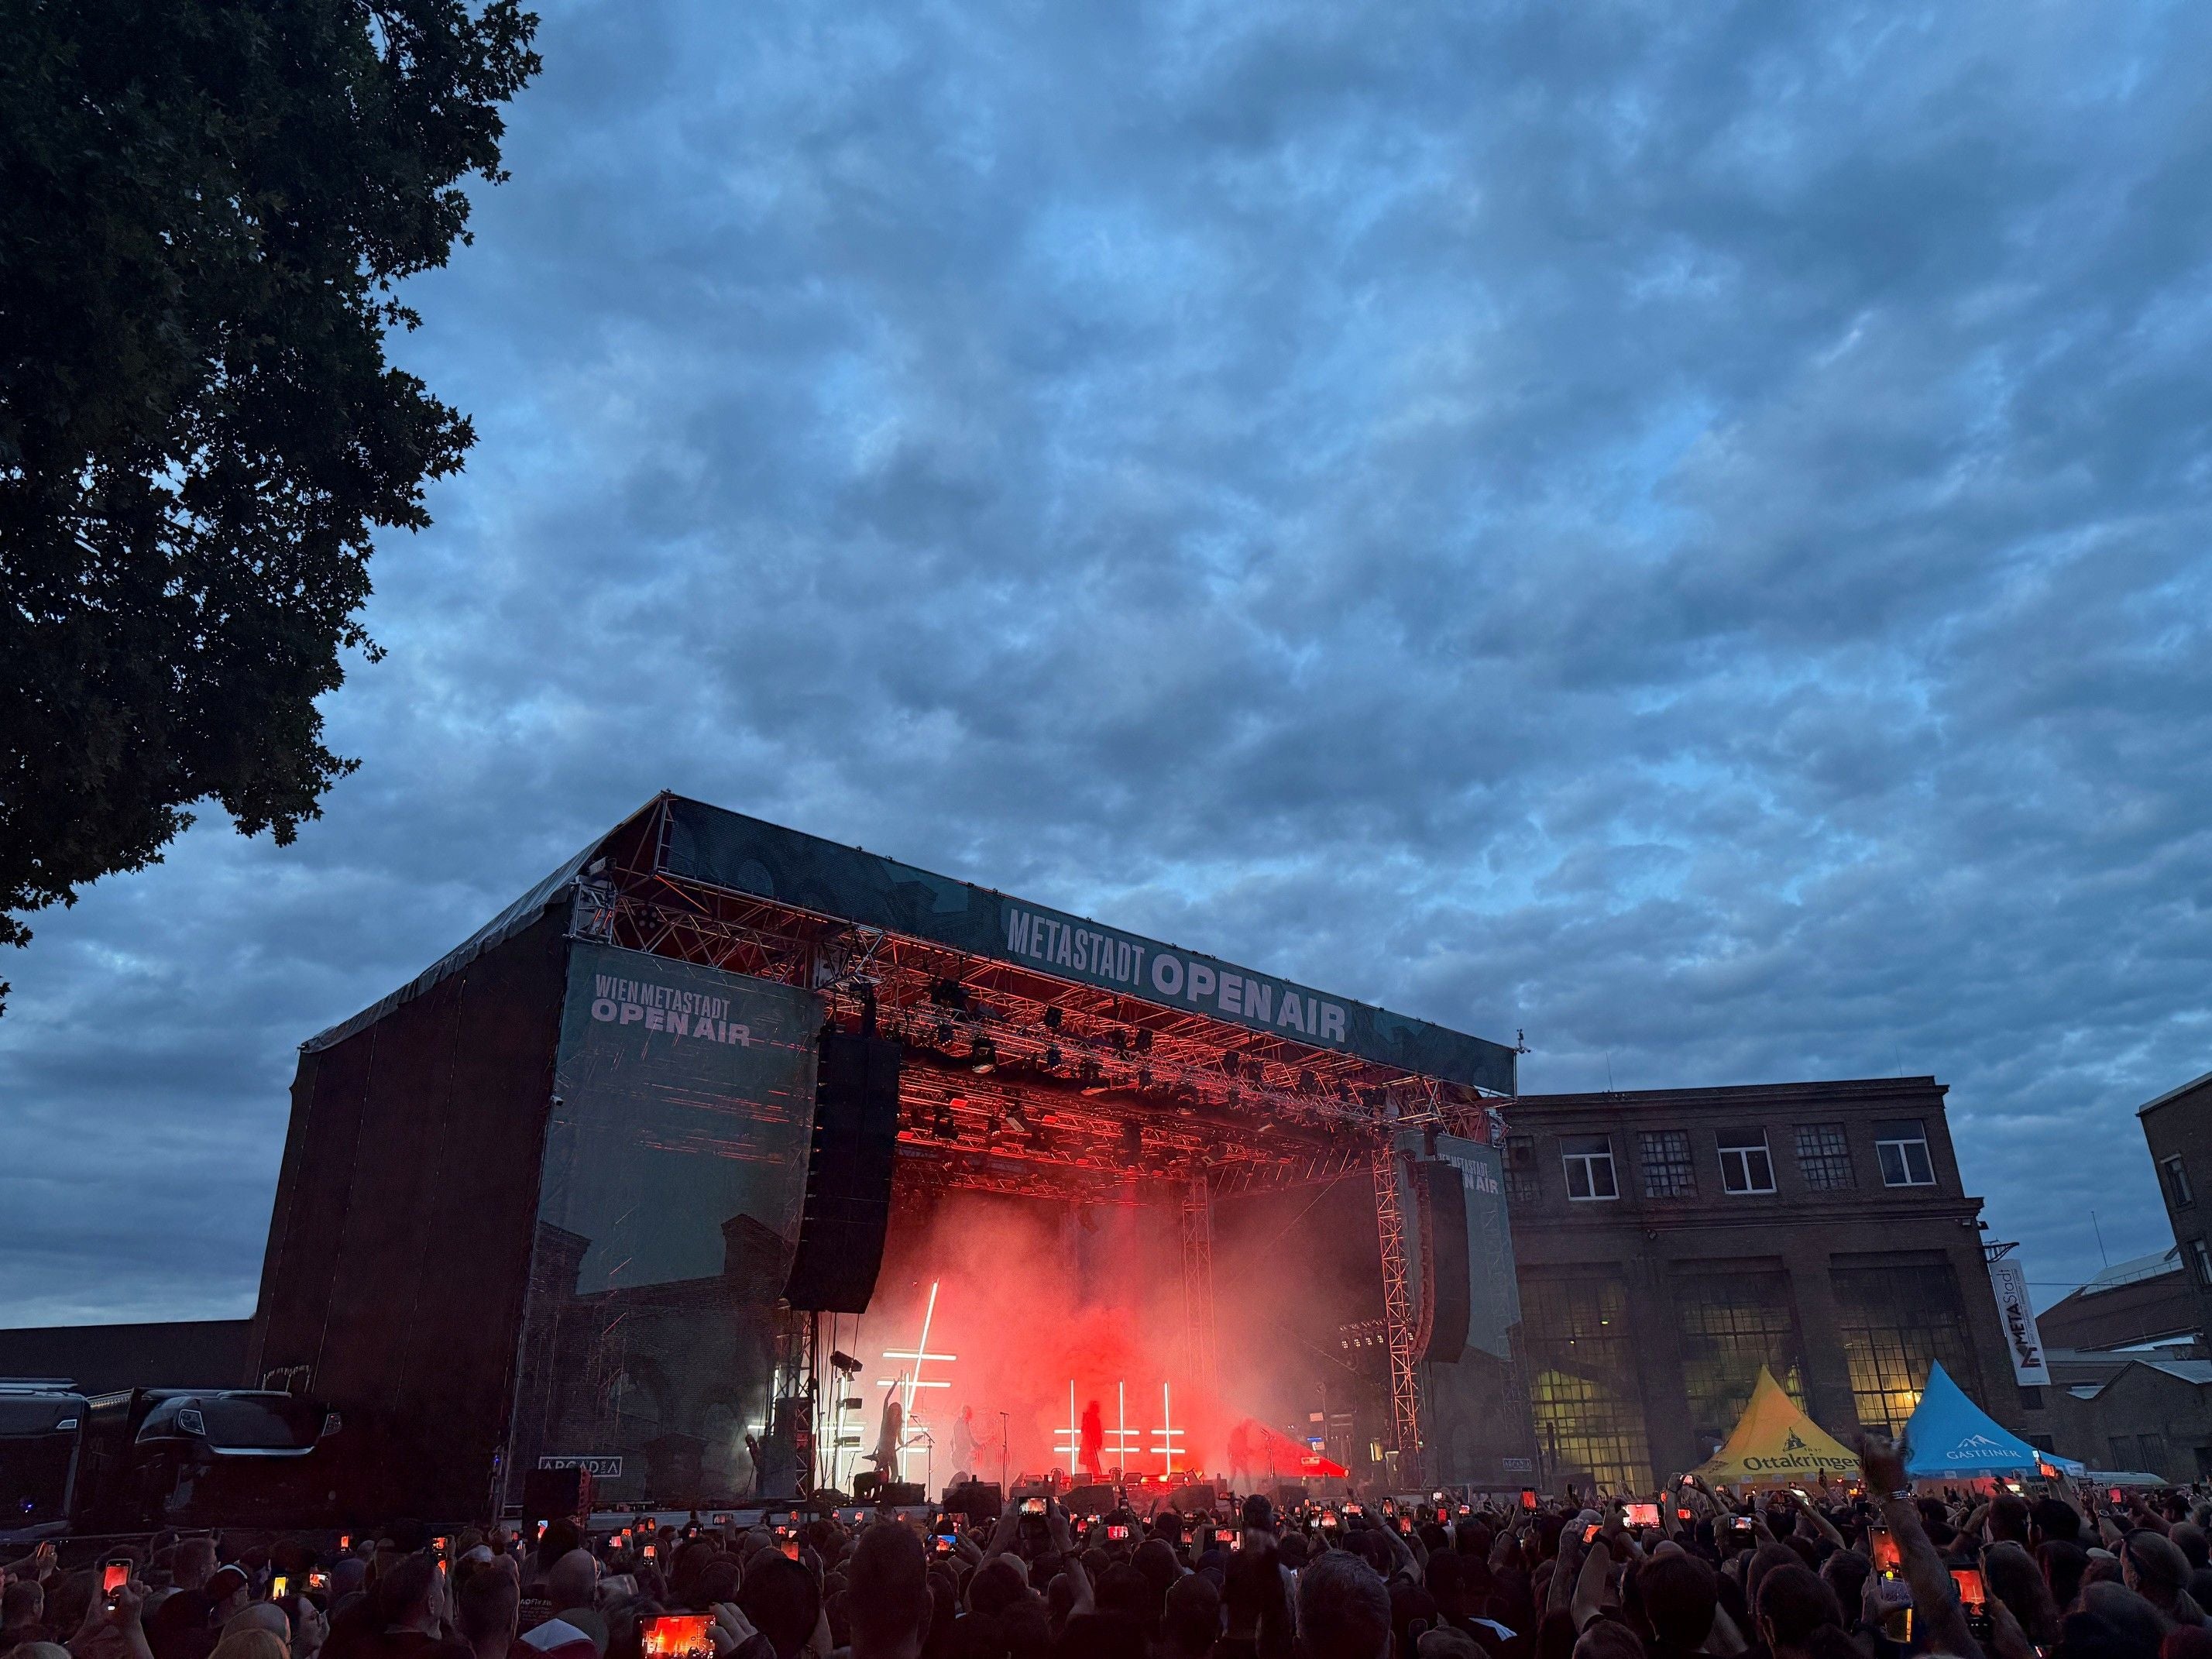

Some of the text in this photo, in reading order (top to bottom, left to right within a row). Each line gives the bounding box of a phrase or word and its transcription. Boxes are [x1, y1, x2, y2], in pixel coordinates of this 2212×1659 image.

[1008, 908, 1346, 1043] METASTADT OPEN AIR
[596, 974, 731, 1021] WIEN METASTADT
[591, 998, 750, 1046] OPEN AIR
[1476, 1176, 1499, 1194] AIR
[1743, 1454, 1860, 1471] Ottakringer
[1946, 1449, 2022, 1460] GASTEINER
